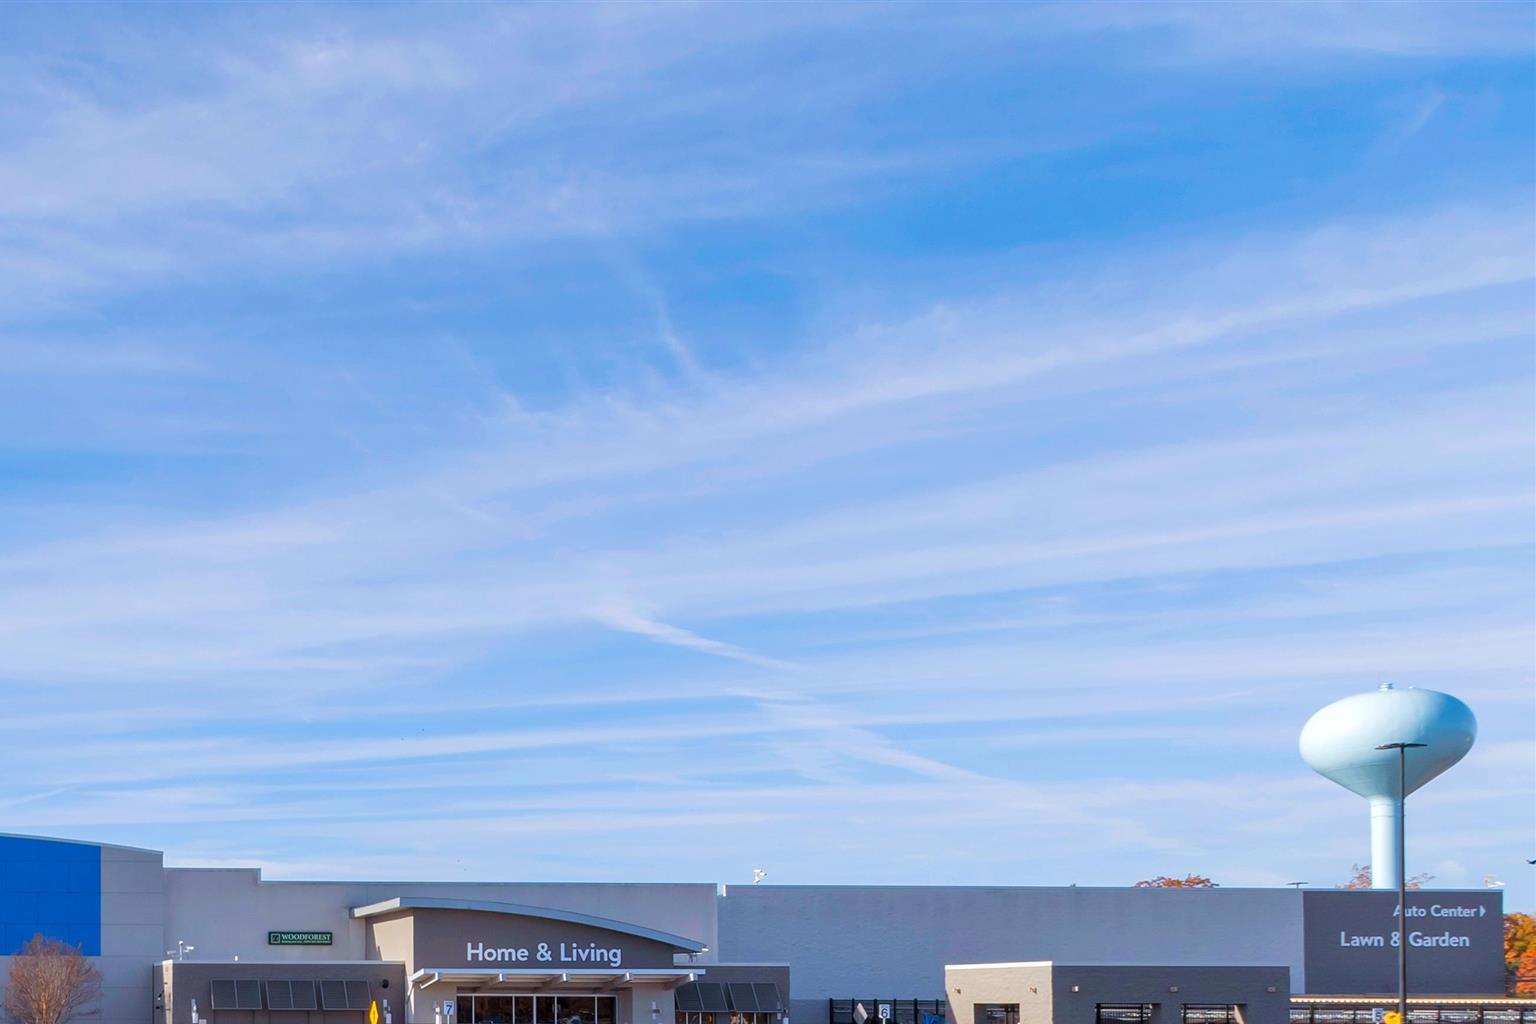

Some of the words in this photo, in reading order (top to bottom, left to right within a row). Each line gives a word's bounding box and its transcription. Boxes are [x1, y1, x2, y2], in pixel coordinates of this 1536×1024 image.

[1393, 904, 1427, 917] Auto
[1430, 904, 1478, 917] Center
[281, 933, 331, 941] WOODFOREST
[1341, 931, 1384, 947] Lawn
[1390, 931, 1402, 947] &
[1408, 931, 1470, 947] Garden
[466, 942, 529, 961] Home
[536, 942, 553, 962] &
[560, 942, 622, 967] Living
